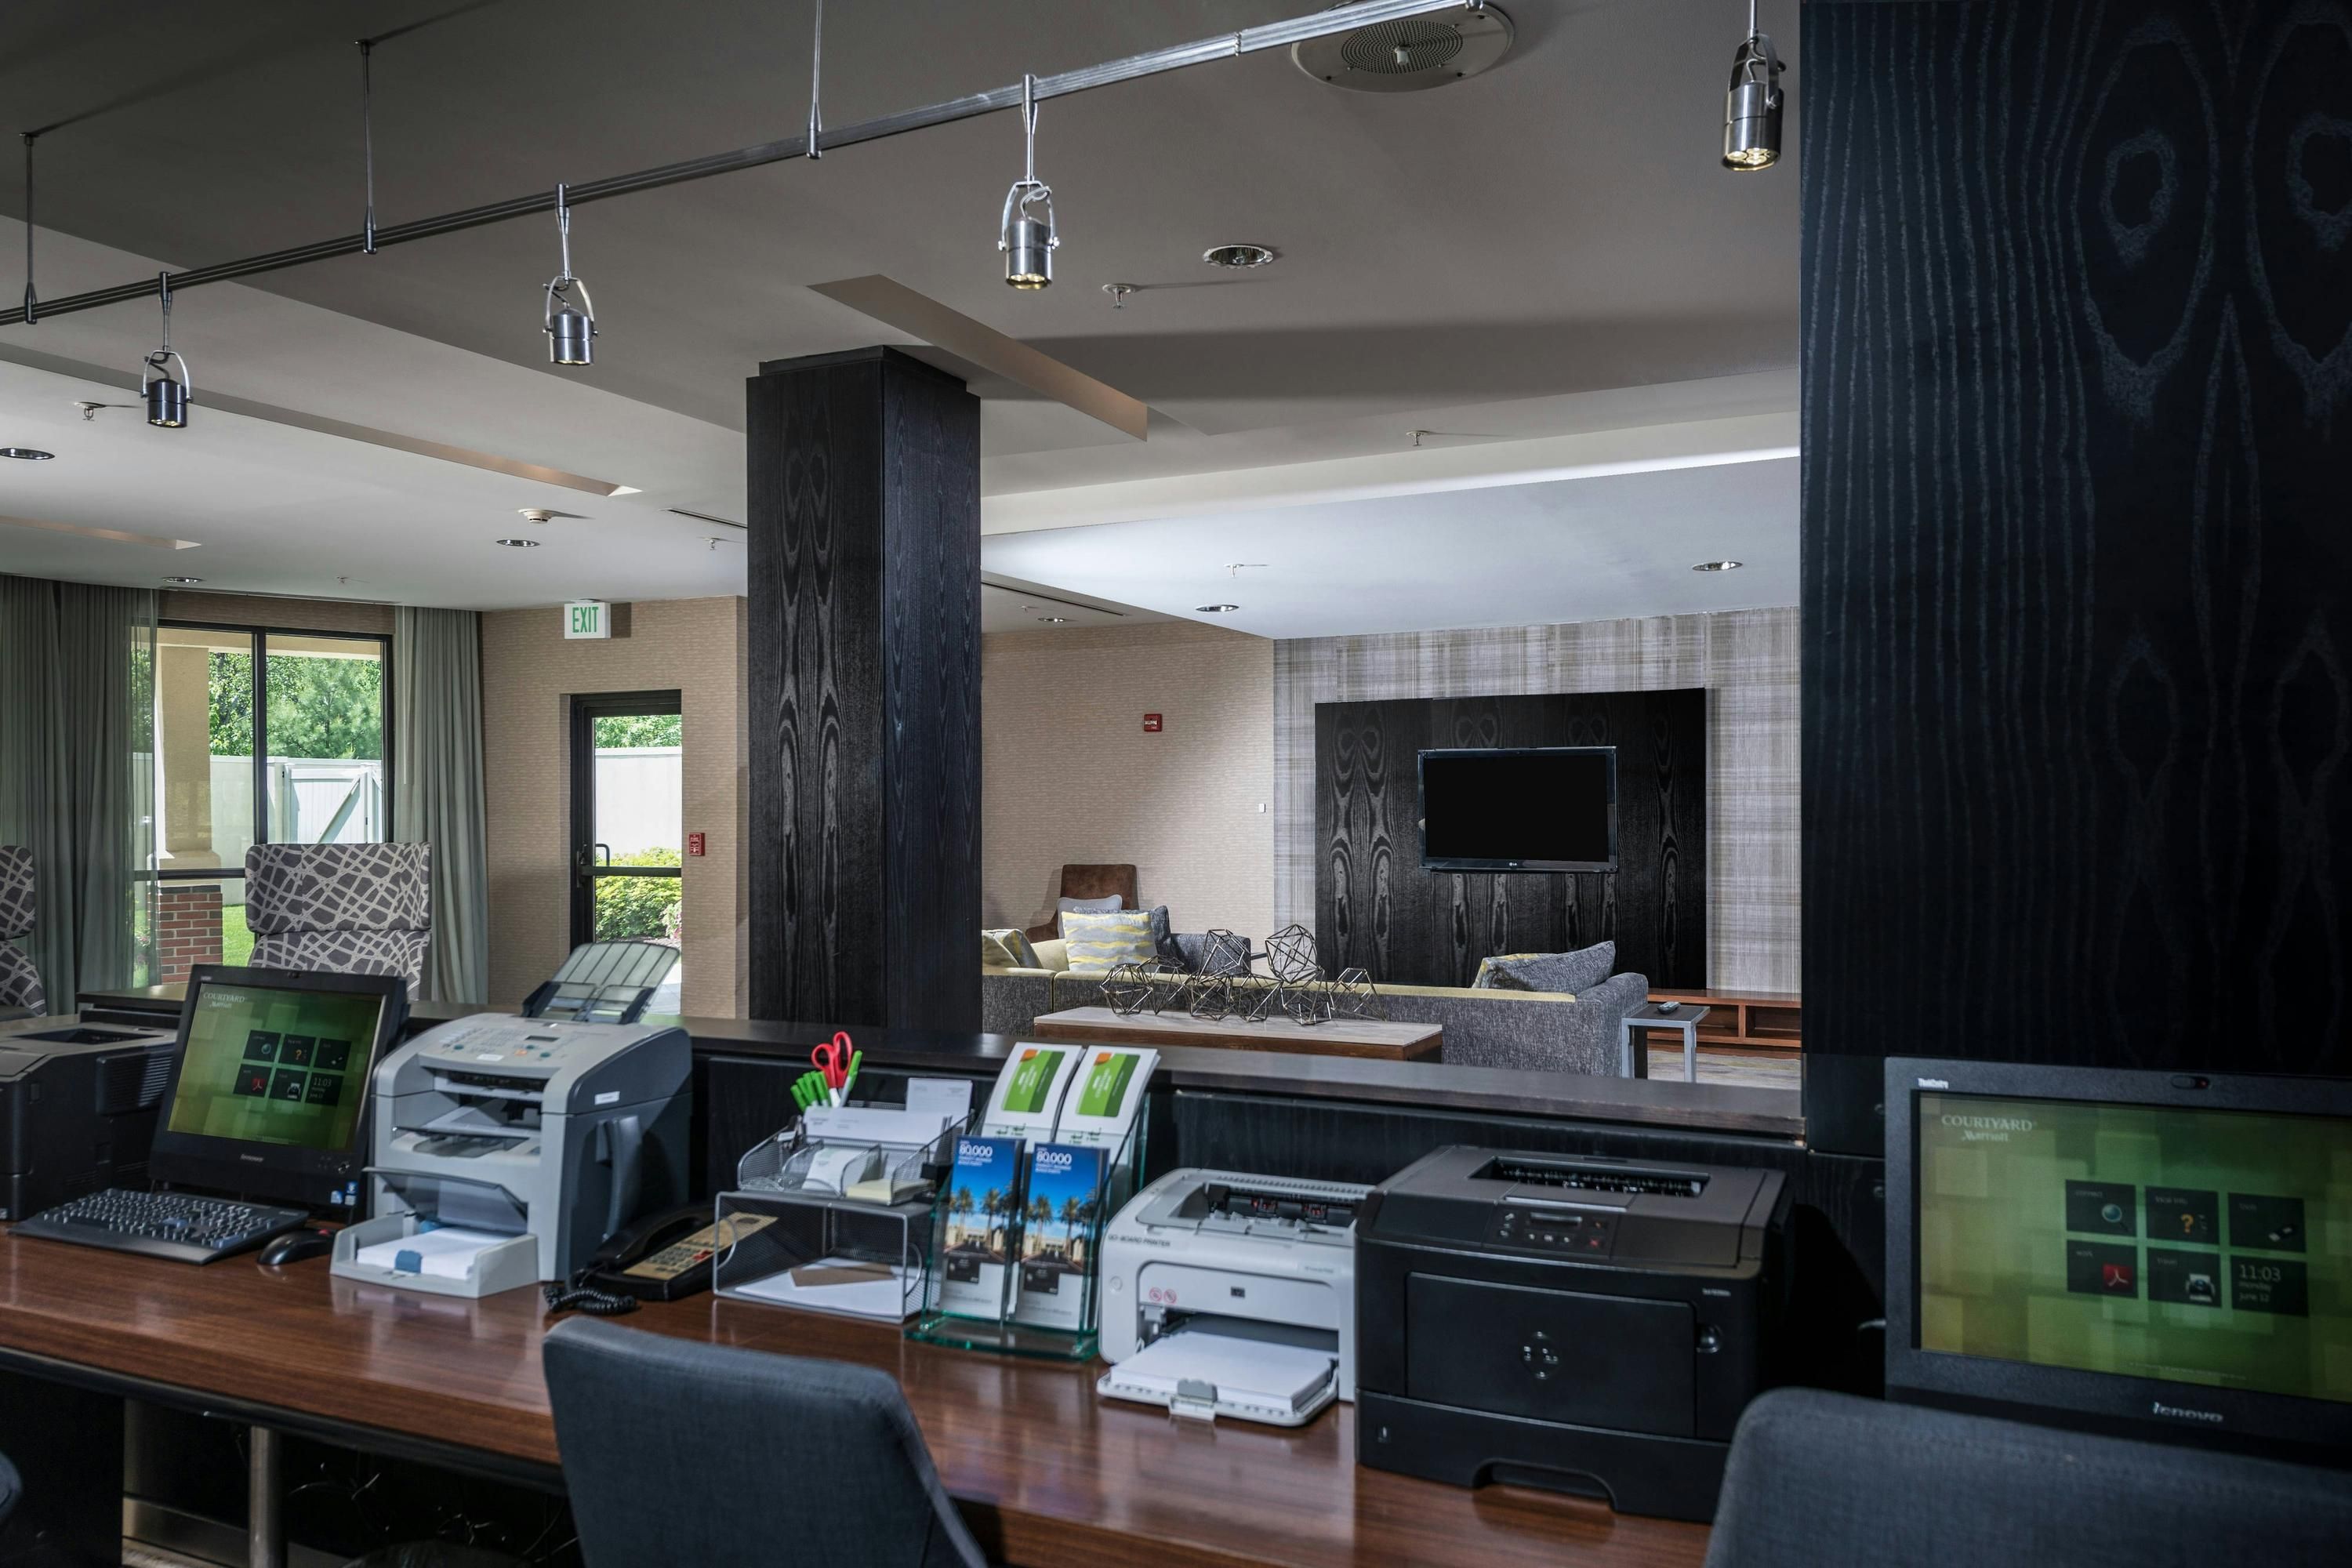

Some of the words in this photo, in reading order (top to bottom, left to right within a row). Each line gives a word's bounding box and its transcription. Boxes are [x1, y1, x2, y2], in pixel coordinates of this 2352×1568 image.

[572, 606, 599, 633] EXIT
[203, 992, 245, 1003] COURTYARD
[314, 1076, 332, 1088] 11:03
[1941, 1114, 2033, 1132] COURTYARD
[1961, 1130, 2009, 1142] Marriott
[1142, 1237, 1171, 1247] PRINTER
[2238, 1264, 2282, 1283] 11:03
[2151, 1401, 2225, 1423] lenovo
